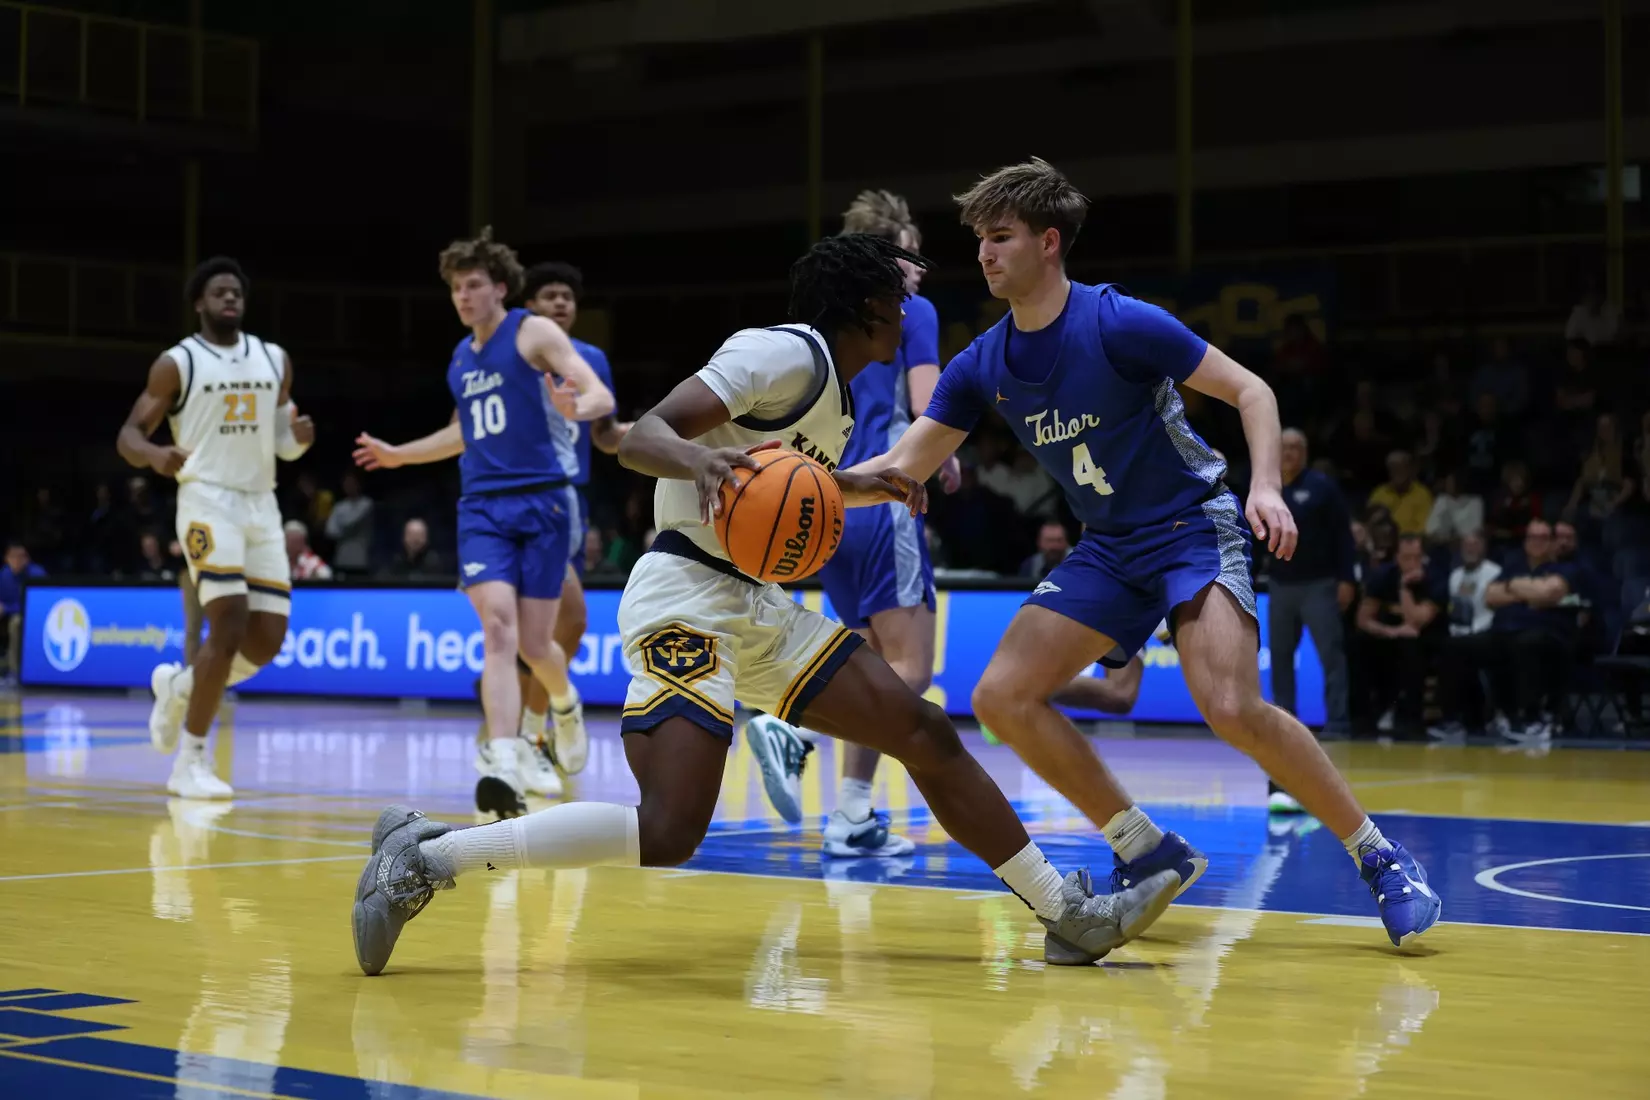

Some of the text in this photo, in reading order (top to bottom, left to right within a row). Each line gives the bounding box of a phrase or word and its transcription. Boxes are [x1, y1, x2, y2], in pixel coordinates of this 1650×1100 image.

[224, 393, 257, 422] 23
[470, 394, 506, 440] 10
[1025, 409, 1100, 447] Tabor
[219, 424, 259, 435] CITY
[1072, 442, 1115, 496] 4
[771, 496, 815, 576] Wilson
